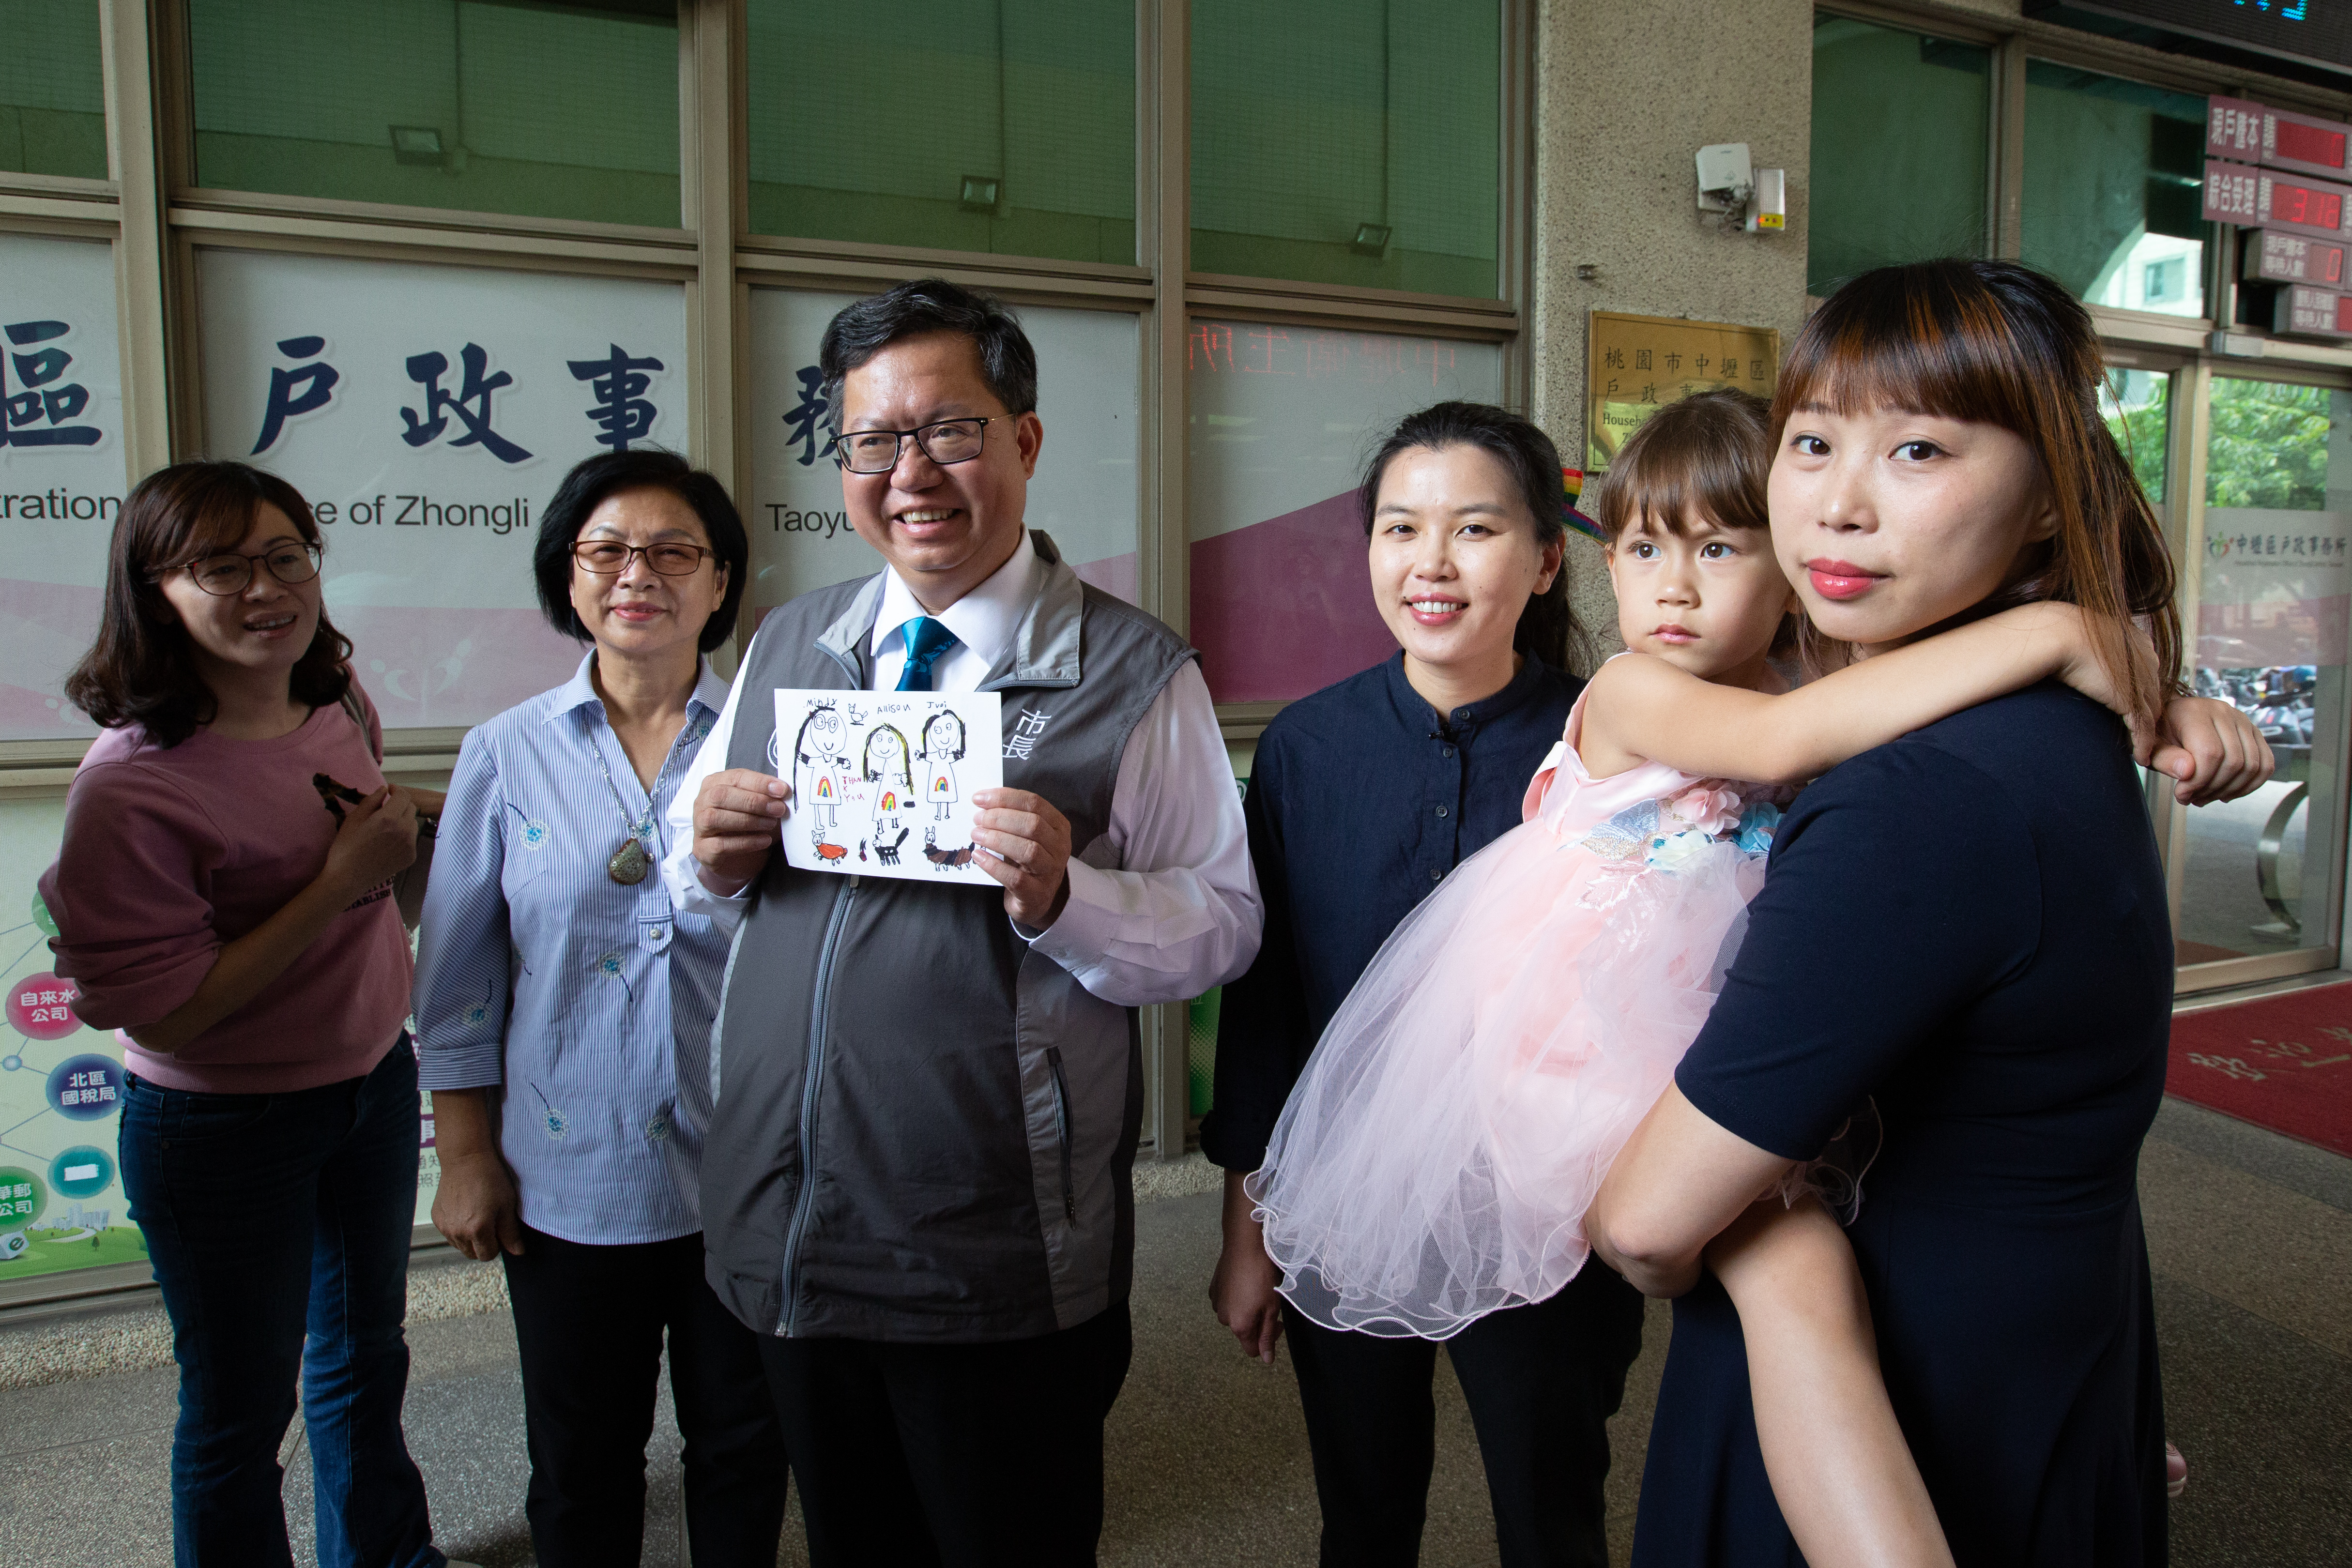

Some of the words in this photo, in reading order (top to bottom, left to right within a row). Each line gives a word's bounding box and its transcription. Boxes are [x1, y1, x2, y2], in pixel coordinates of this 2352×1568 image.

[1605, 346, 1765, 381] 桃園市中壢區
[349, 495, 386, 525] of
[395, 495, 528, 534] Zhongli
[807, 697, 837, 707] Mindy
[1002, 708, 1052, 760] 市長
[21, 988, 76, 1006] 自來水
[31, 1006, 68, 1022] 公司
[69, 1070, 107, 1087] 北區
[61, 1086, 117, 1106] 國稅局
[0, 1200, 33, 1217] 公司
